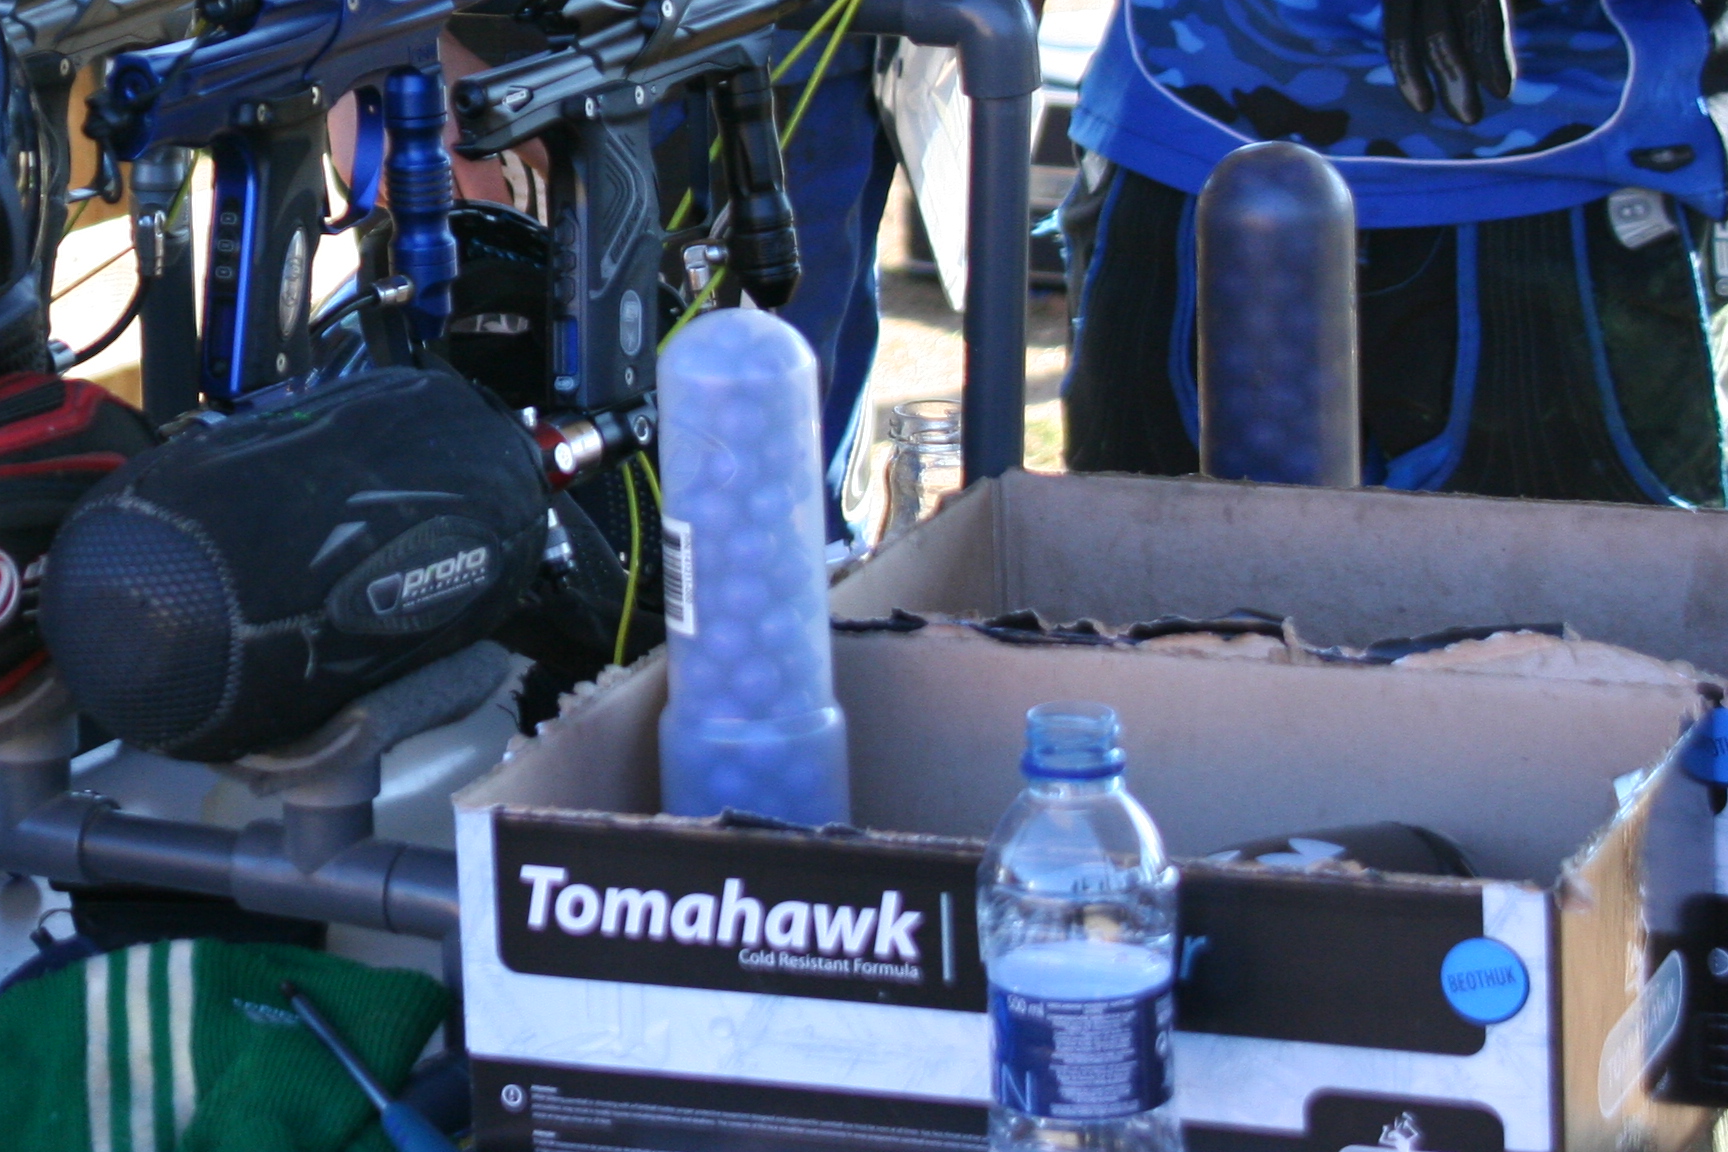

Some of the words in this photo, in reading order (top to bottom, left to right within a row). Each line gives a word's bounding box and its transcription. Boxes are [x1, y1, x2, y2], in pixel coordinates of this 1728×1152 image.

[402, 547, 487, 598] proto
[520, 863, 923, 961] Tomahawk
[738, 948, 775, 968] Cold
[779, 951, 850, 975] Resistant
[853, 957, 920, 980] Formula
[1447, 966, 1516, 993] BEOTHUK
